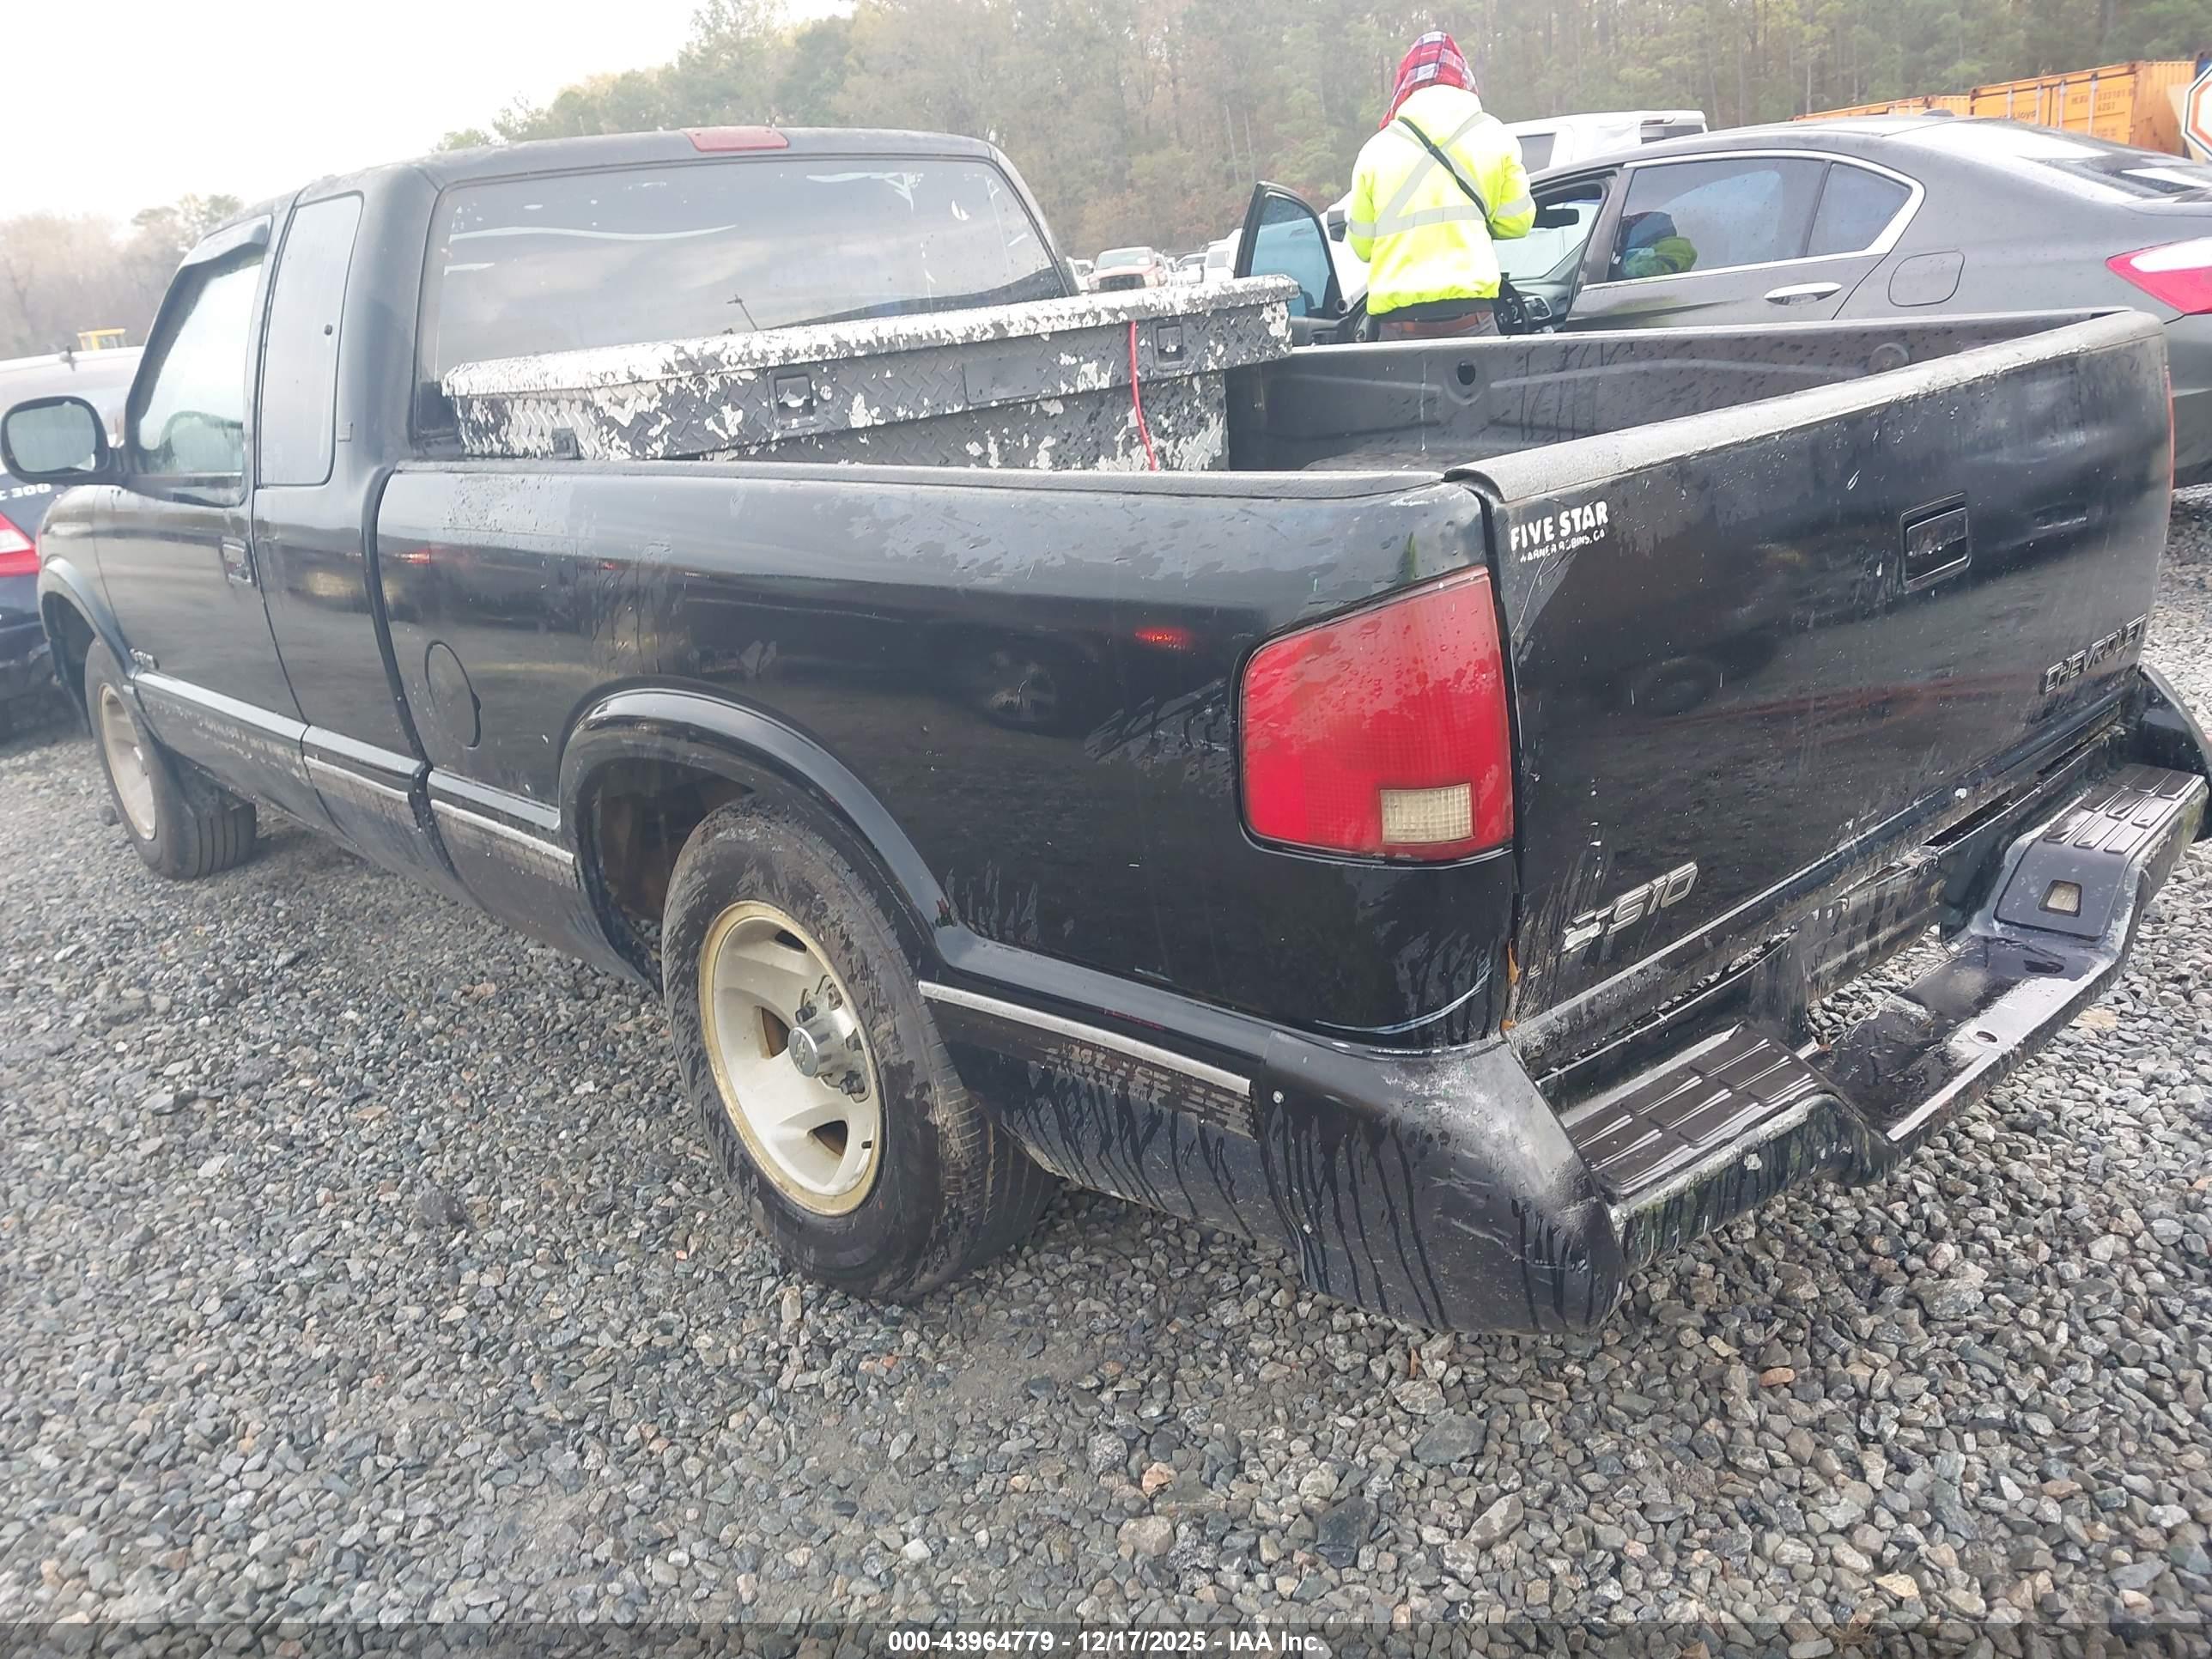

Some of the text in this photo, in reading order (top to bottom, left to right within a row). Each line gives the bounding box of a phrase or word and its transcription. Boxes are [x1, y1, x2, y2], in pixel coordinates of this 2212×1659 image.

[10, 483, 52, 498] 300
[1510, 501, 1609, 551] FIVE STAR
[2044, 613, 2147, 694] CHEVROLET
